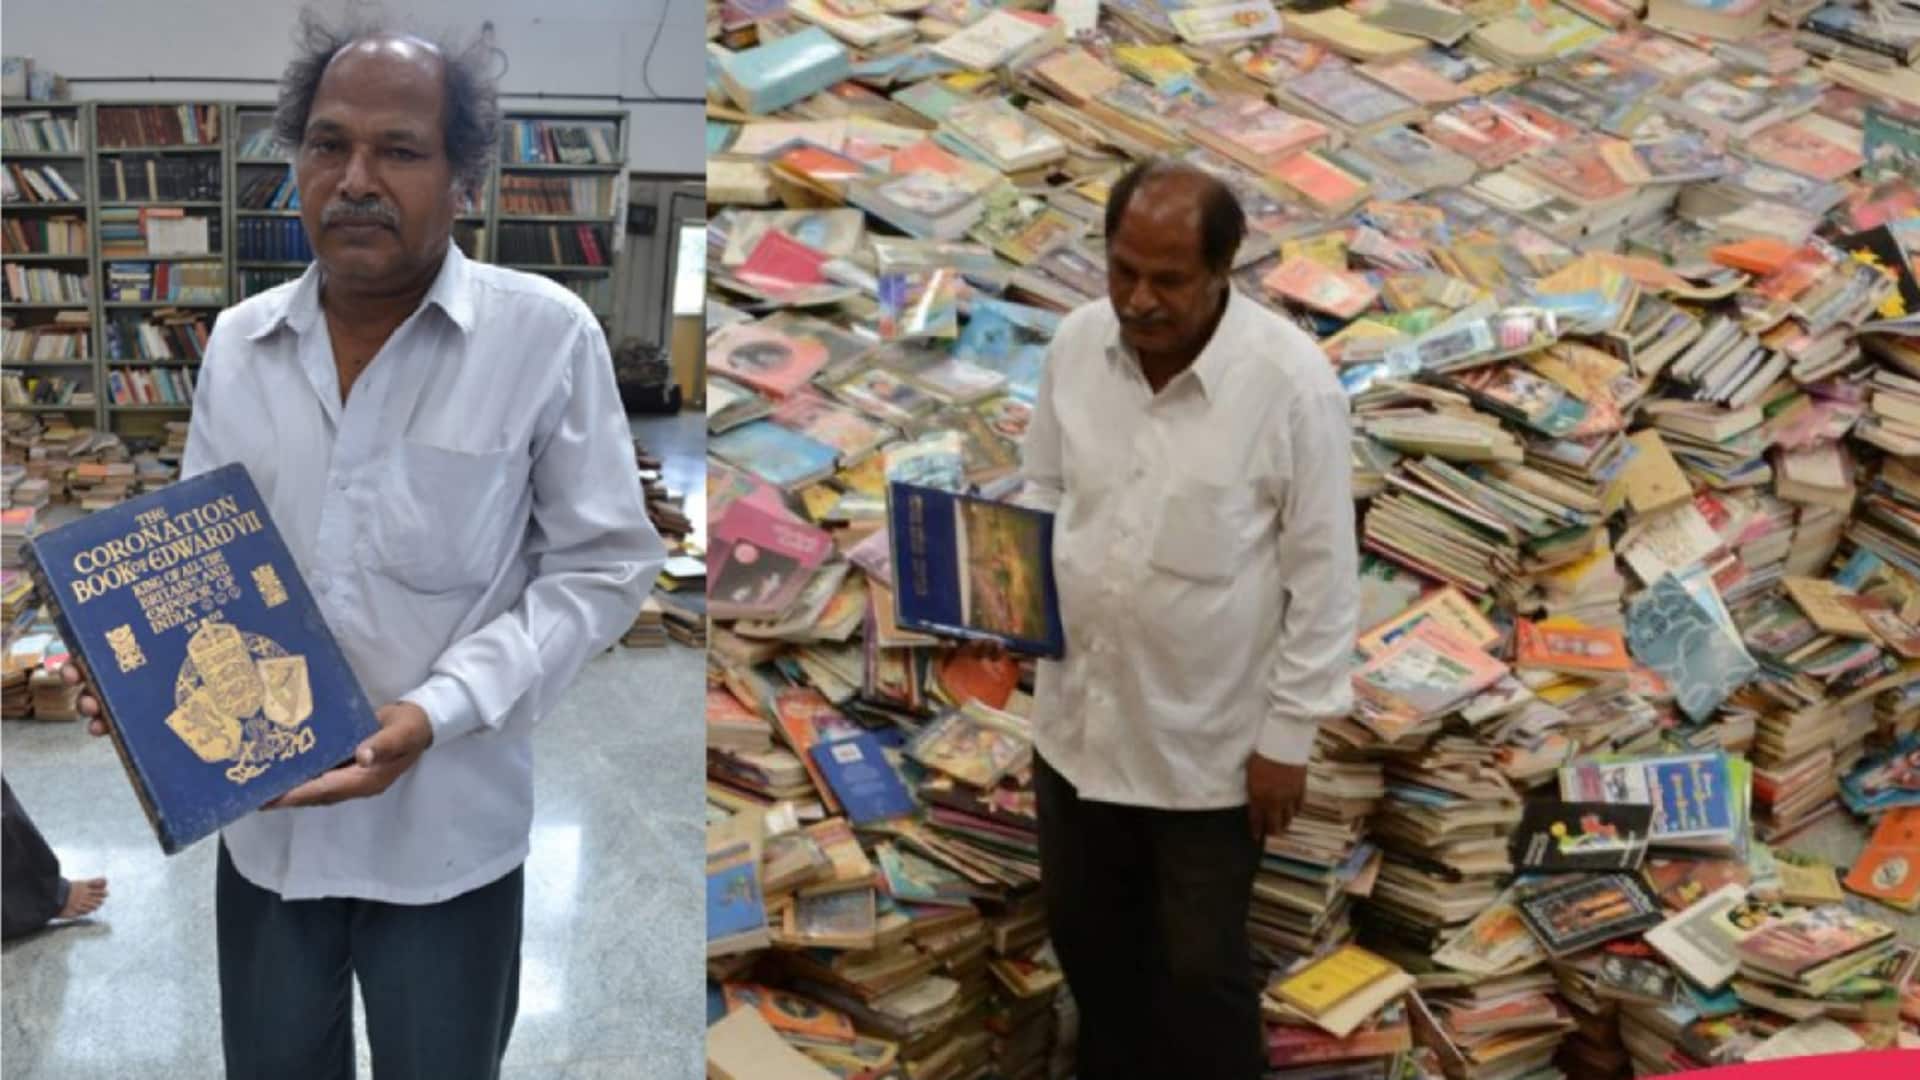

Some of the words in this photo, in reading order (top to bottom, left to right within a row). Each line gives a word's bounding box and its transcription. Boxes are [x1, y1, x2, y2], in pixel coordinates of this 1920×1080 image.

[135, 506, 168, 527] THE
[73, 495, 240, 574] CORONATION
[71, 562, 139, 604] BOOK
[148, 522, 236, 571] EDWARD
[232, 510, 264, 536] VII
[132, 576, 165, 597] KING
[163, 568, 181, 582] OF
[182, 561, 203, 577] ALL
[202, 562, 231, 583] AND
[216, 573, 235, 591] OF
[150, 605, 197, 634] INDIA
